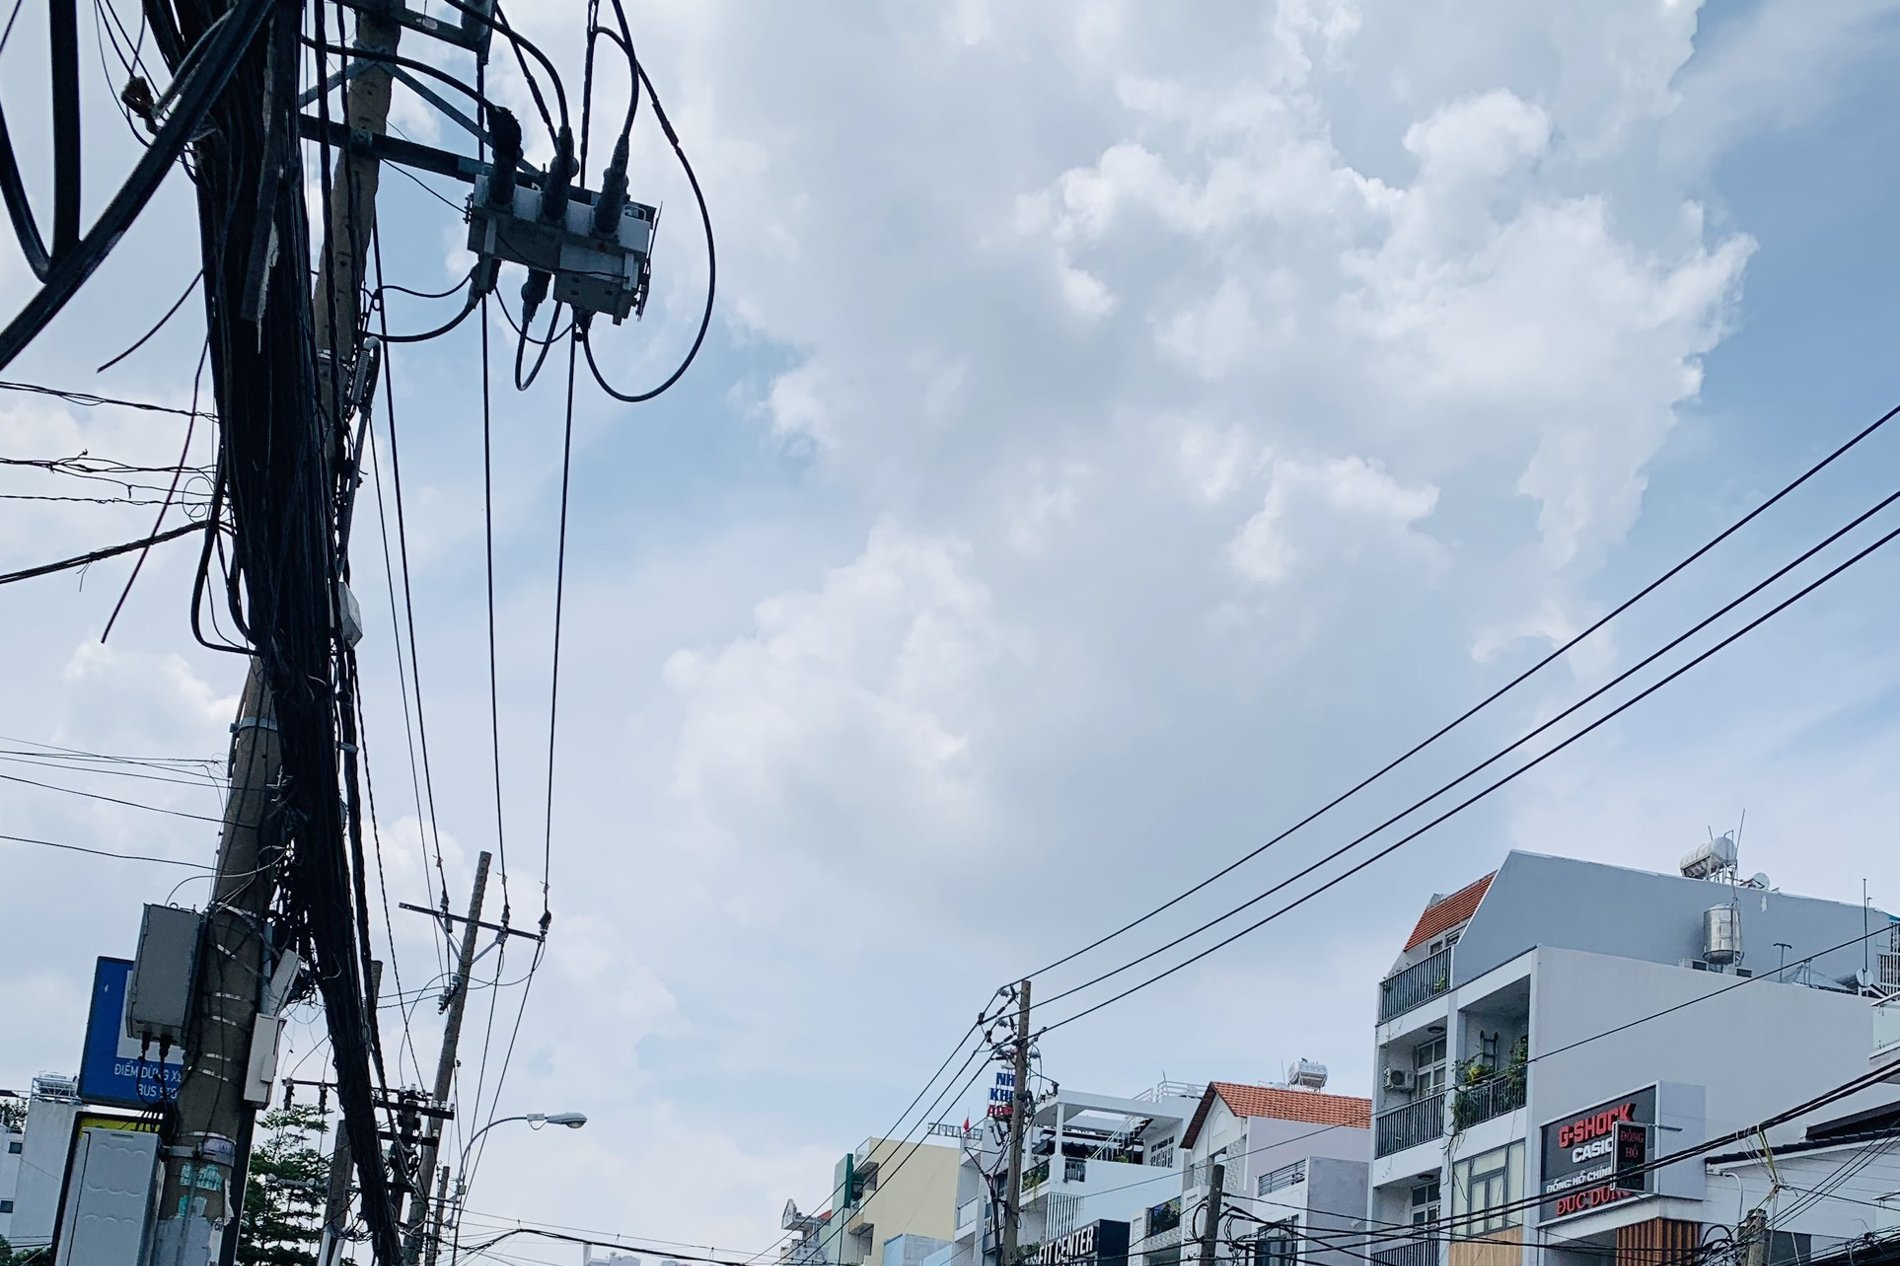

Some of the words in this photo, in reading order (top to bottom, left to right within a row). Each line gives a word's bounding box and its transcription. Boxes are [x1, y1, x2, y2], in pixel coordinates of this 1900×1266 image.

[114, 1060, 138, 1078] ĐIỂM
[141, 1064, 169, 1081] DỪG
[996, 1072, 1016, 1087] NH
[1558, 1103, 1634, 1149] G-SHOCK
[1572, 1136, 1614, 1163] CASIO
[1055, 1225, 1095, 1265] CENTER
